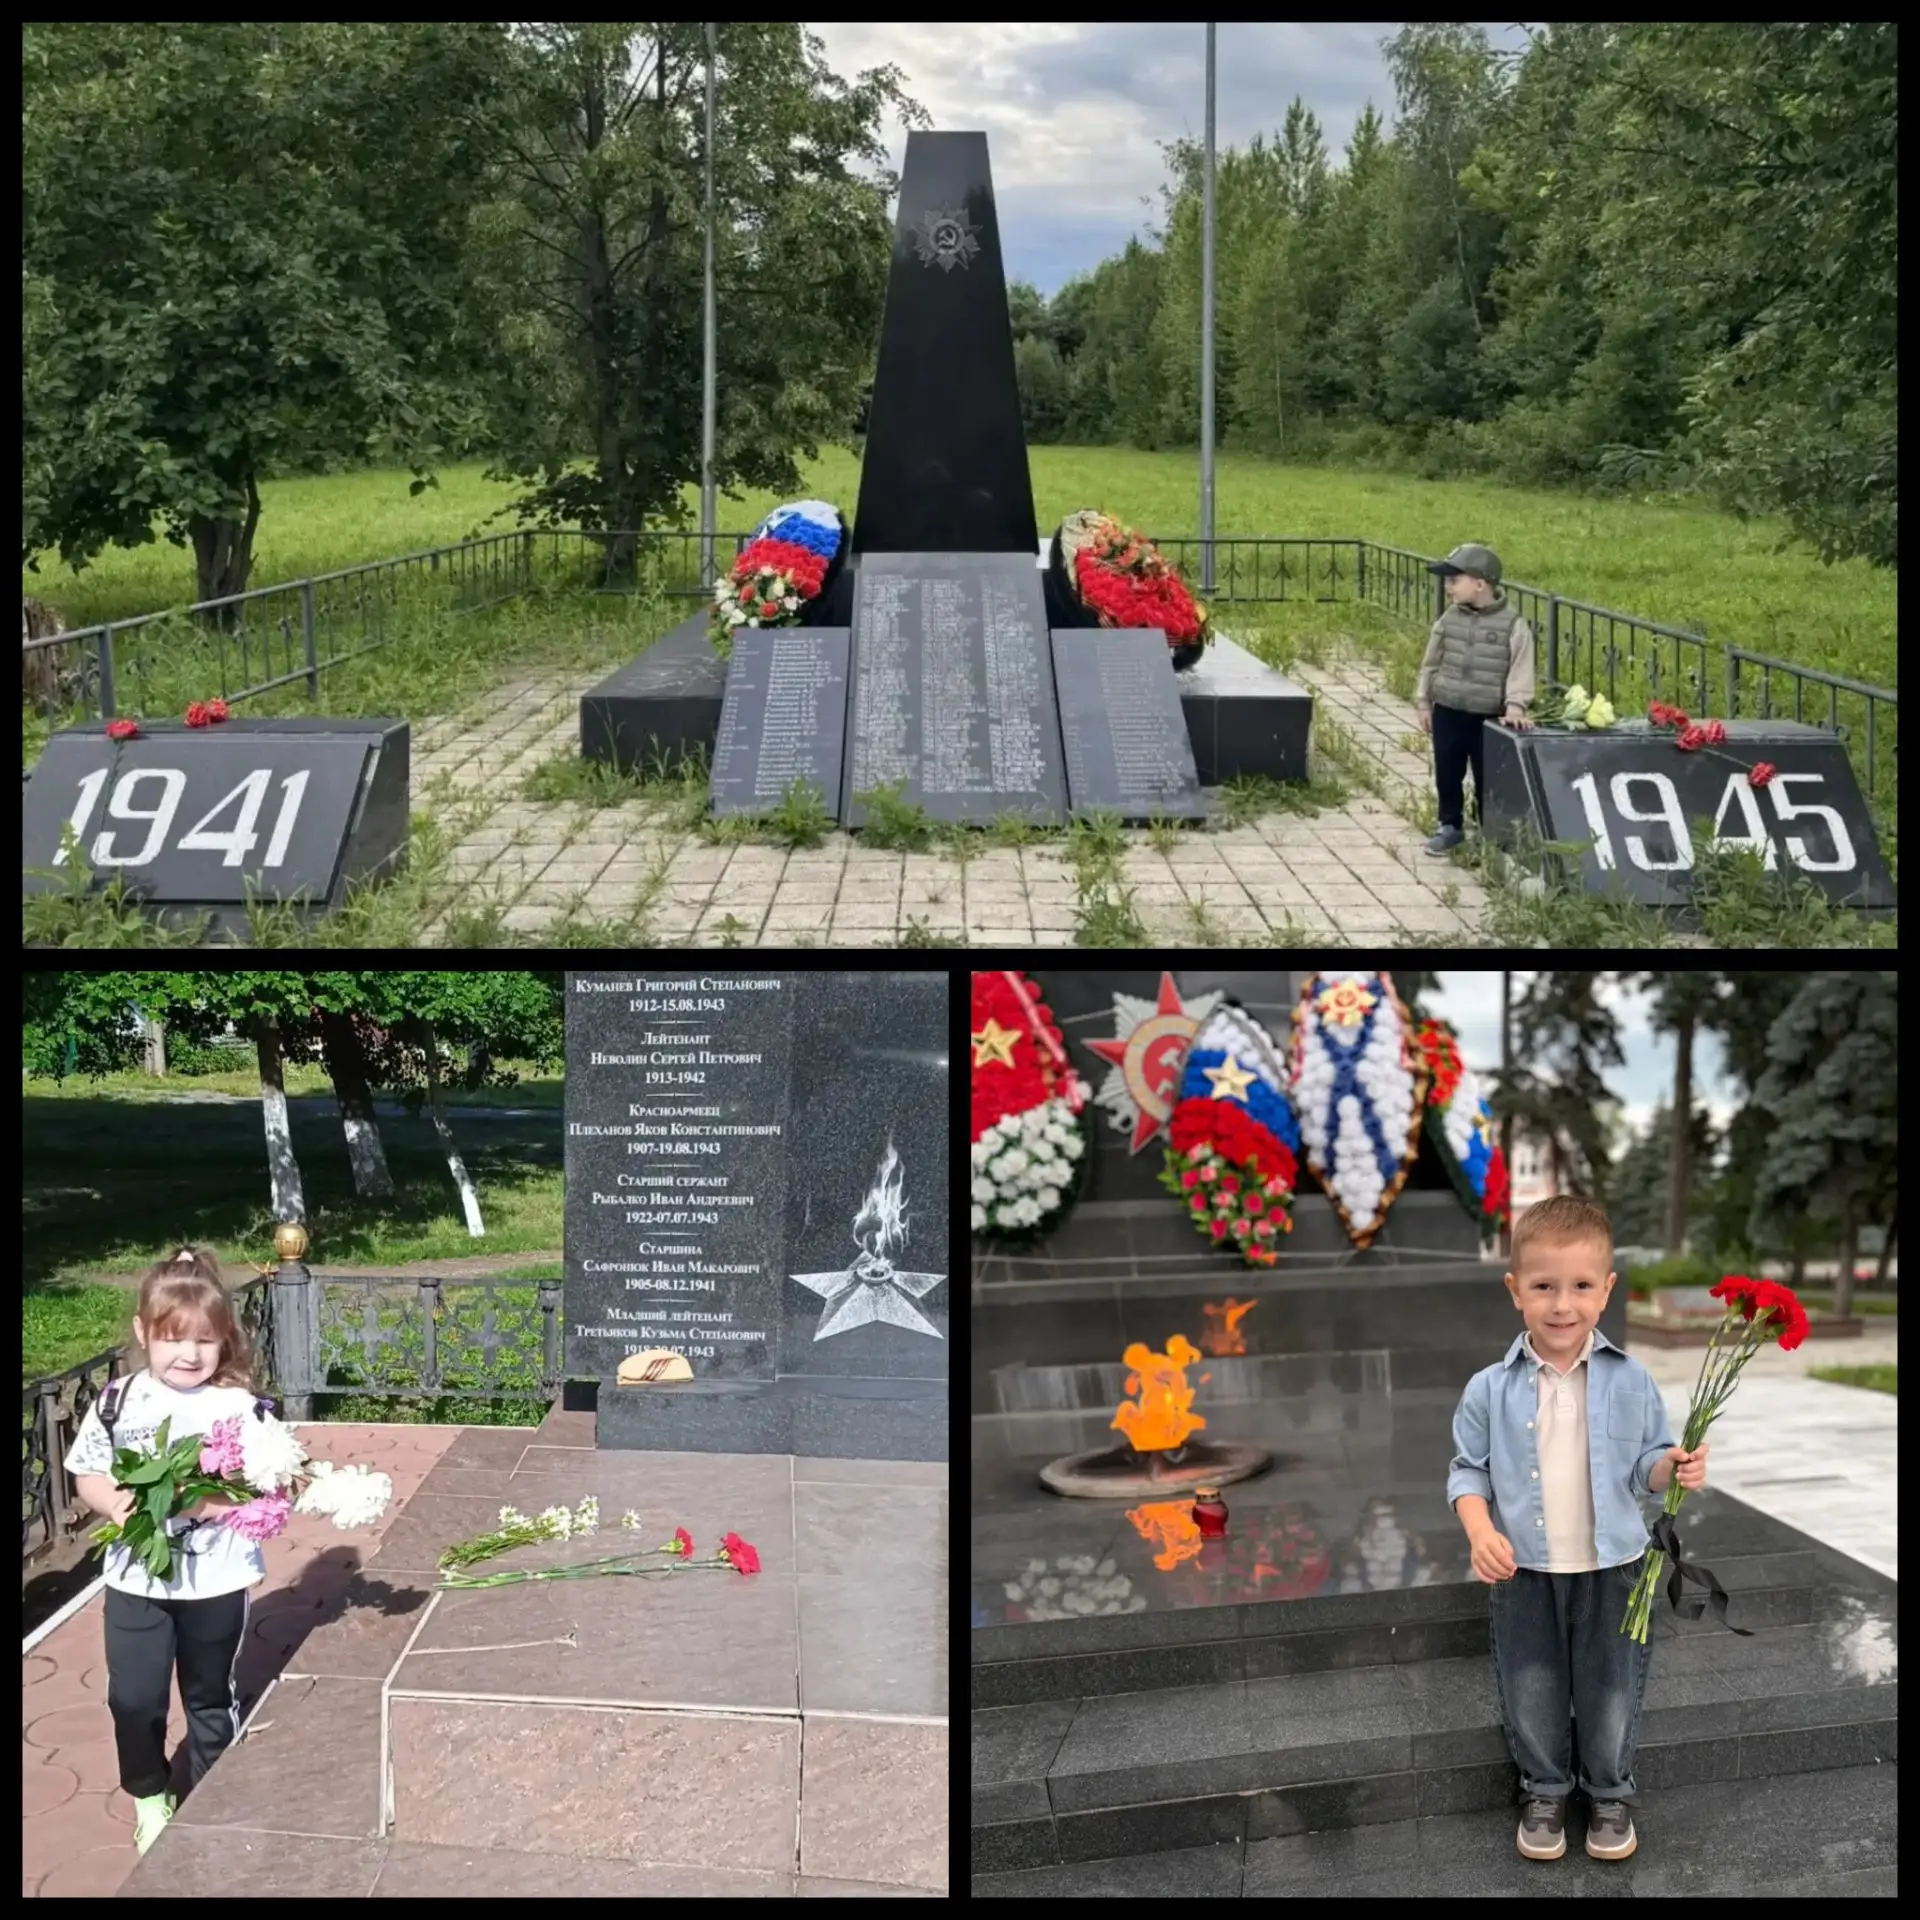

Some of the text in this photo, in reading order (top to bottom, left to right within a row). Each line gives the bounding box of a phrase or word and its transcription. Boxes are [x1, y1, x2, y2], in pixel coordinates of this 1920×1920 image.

[52, 768, 311, 867] 1941
[1571, 771, 1857, 872] 1945
[629, 998, 725, 1012] 1912-15.08.1943
[645, 1071, 706, 1084] 1913-1942
[627, 1142, 721, 1155] 1907-19.08.1943
[626, 1211, 719, 1224] 1922-07.07.1943
[625, 1278, 716, 1292] 1905-08.12.1941
[624, 1344, 715, 1357] 19107.1943
